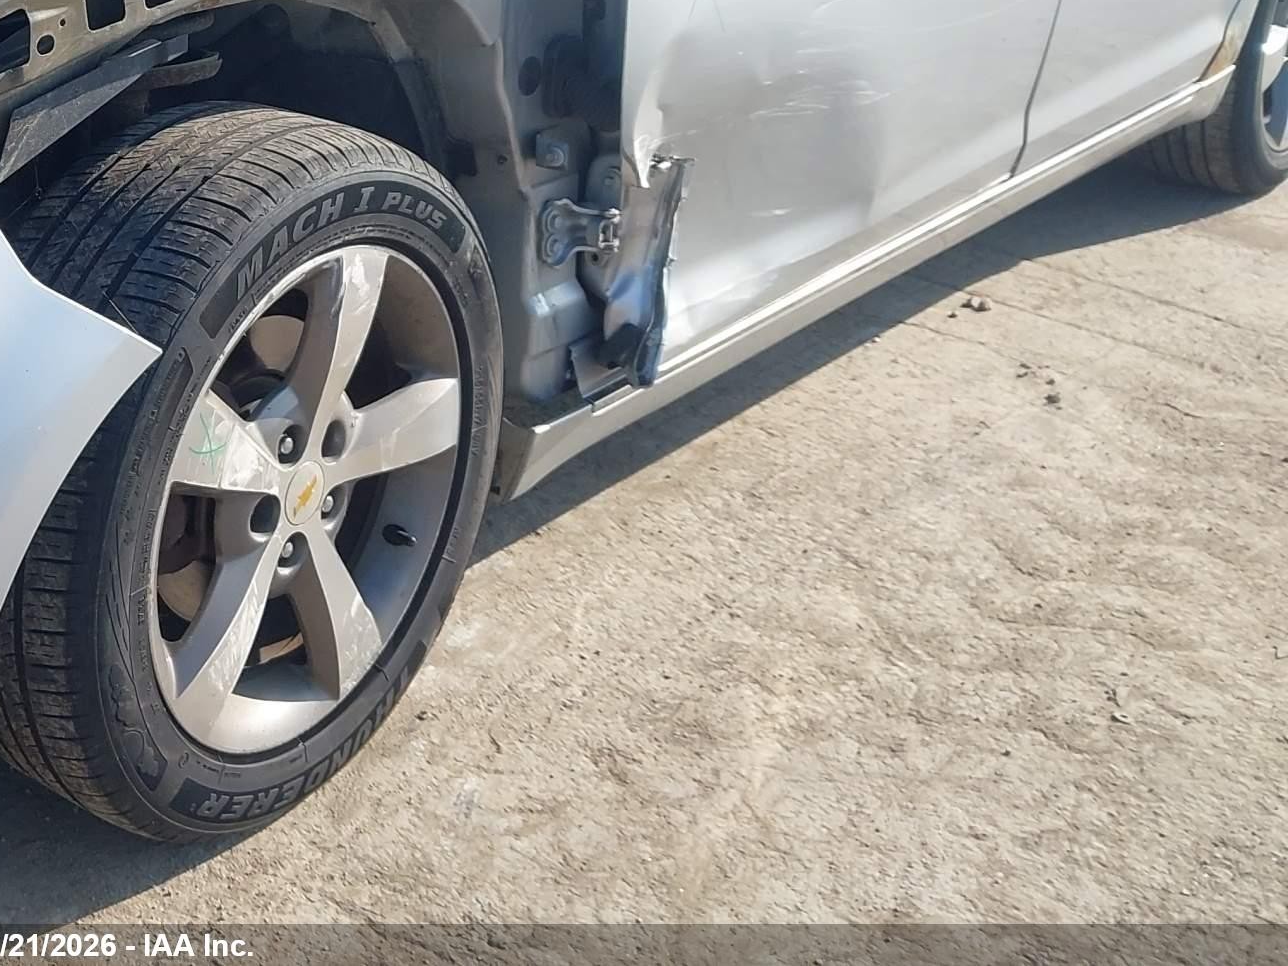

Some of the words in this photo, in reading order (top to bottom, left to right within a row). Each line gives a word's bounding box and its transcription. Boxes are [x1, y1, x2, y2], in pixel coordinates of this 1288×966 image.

[237, 192, 344, 300] MACH
[353, 186, 376, 212] I
[380, 191, 449, 231] PLUS
